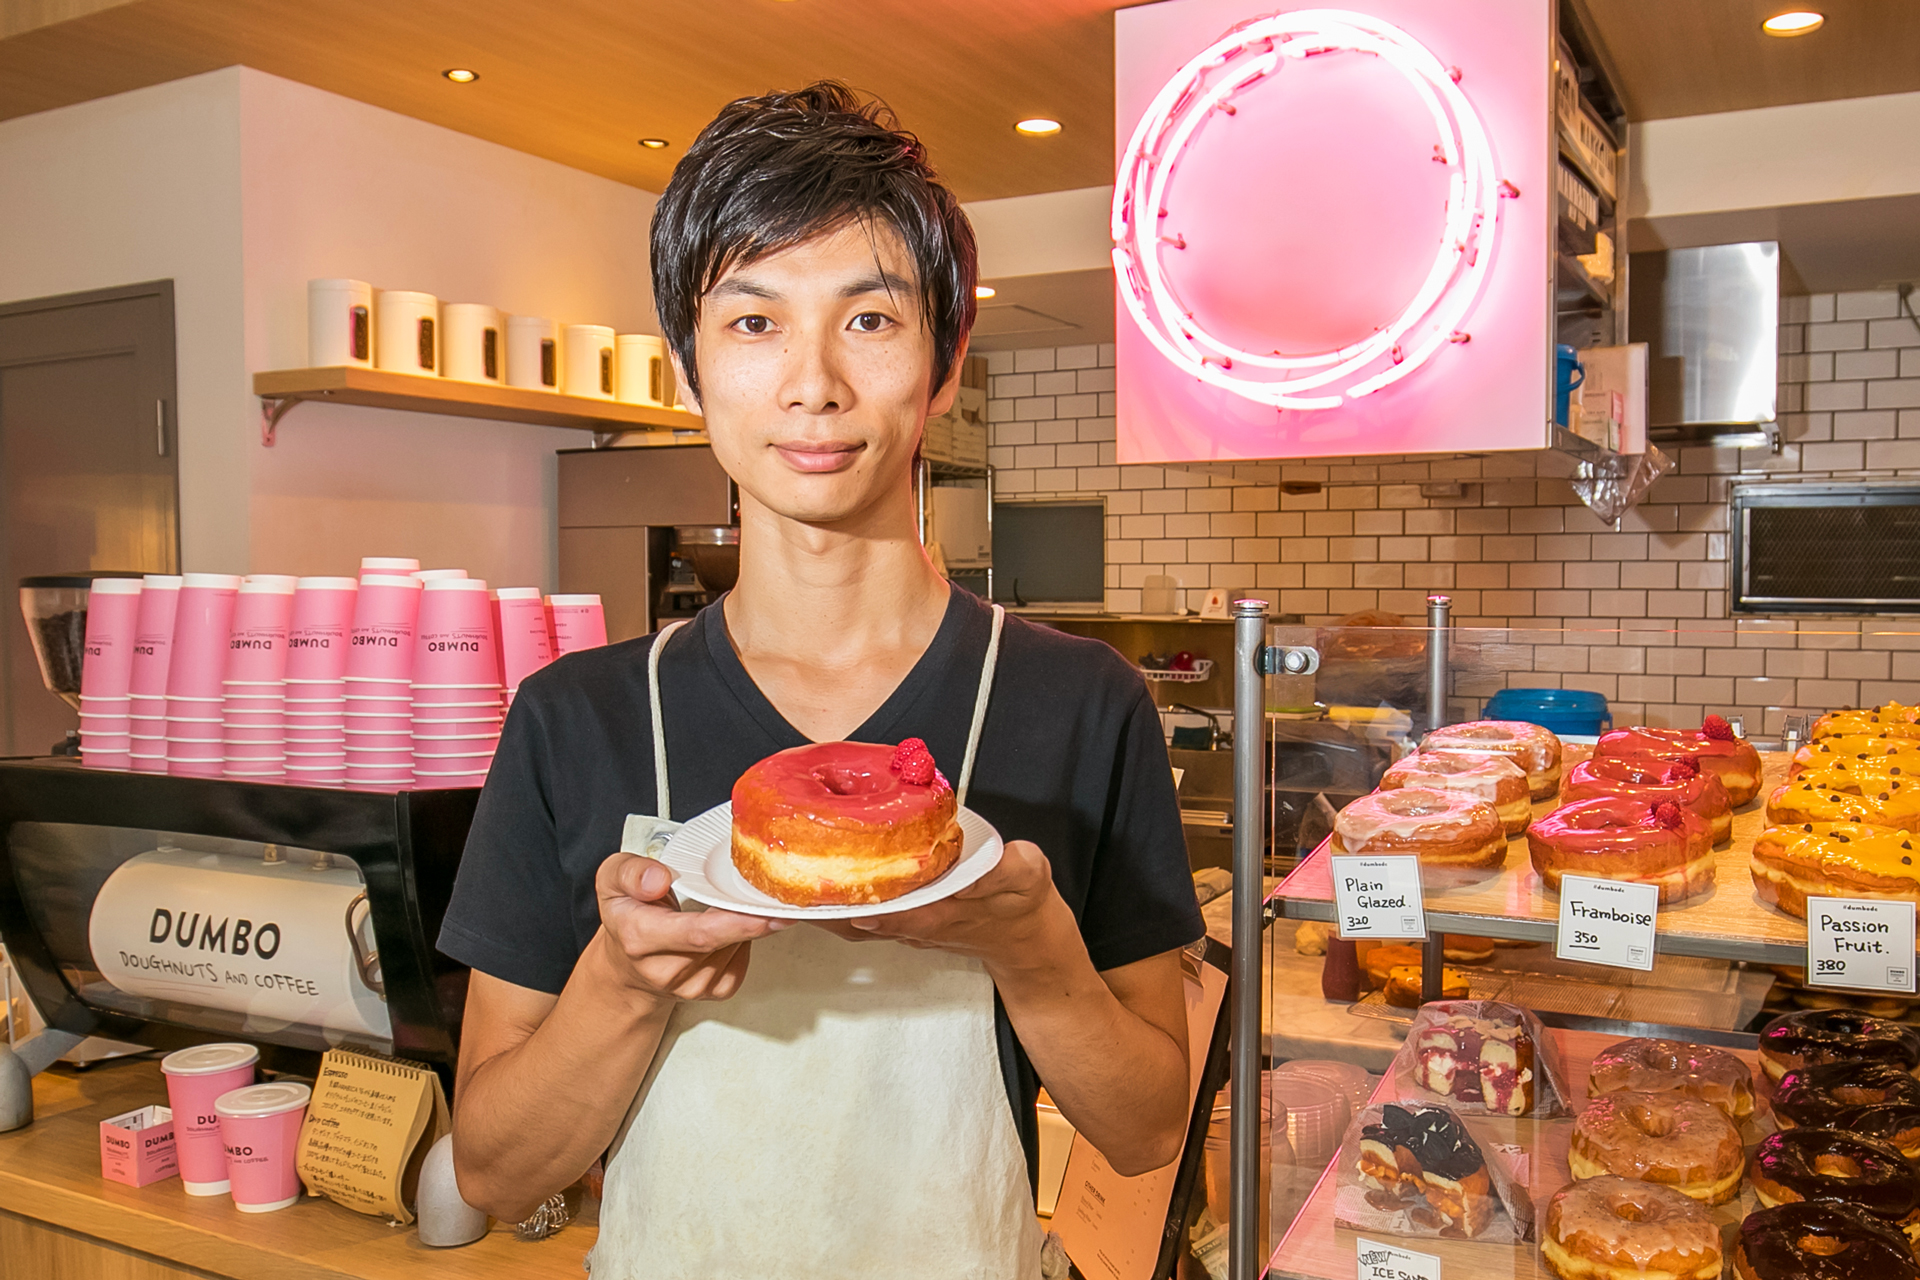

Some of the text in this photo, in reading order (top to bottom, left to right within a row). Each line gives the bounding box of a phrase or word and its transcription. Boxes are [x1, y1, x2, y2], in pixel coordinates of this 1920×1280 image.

[352, 636, 398, 647] DUMBO
[428, 641, 479, 652] DUMBO
[1345, 877, 1383, 892] Plain
[1570, 900, 1652, 926] Framboise
[1347, 916, 1369, 928] 320
[1821, 914, 1889, 933] Passion
[149, 908, 281, 960] DUMBO
[1574, 930, 1598, 943] 350
[1834, 937, 1889, 954] Fruit.
[1816, 959, 1846, 971] 380
[119, 950, 320, 996] DOUGHNUTS AND COFFEE
[197, 1115, 218, 1125] DU
[106, 1135, 130, 1149] DUMBO
[224, 1146, 254, 1156] MBO
[1371, 1266, 1395, 1279] ICE
